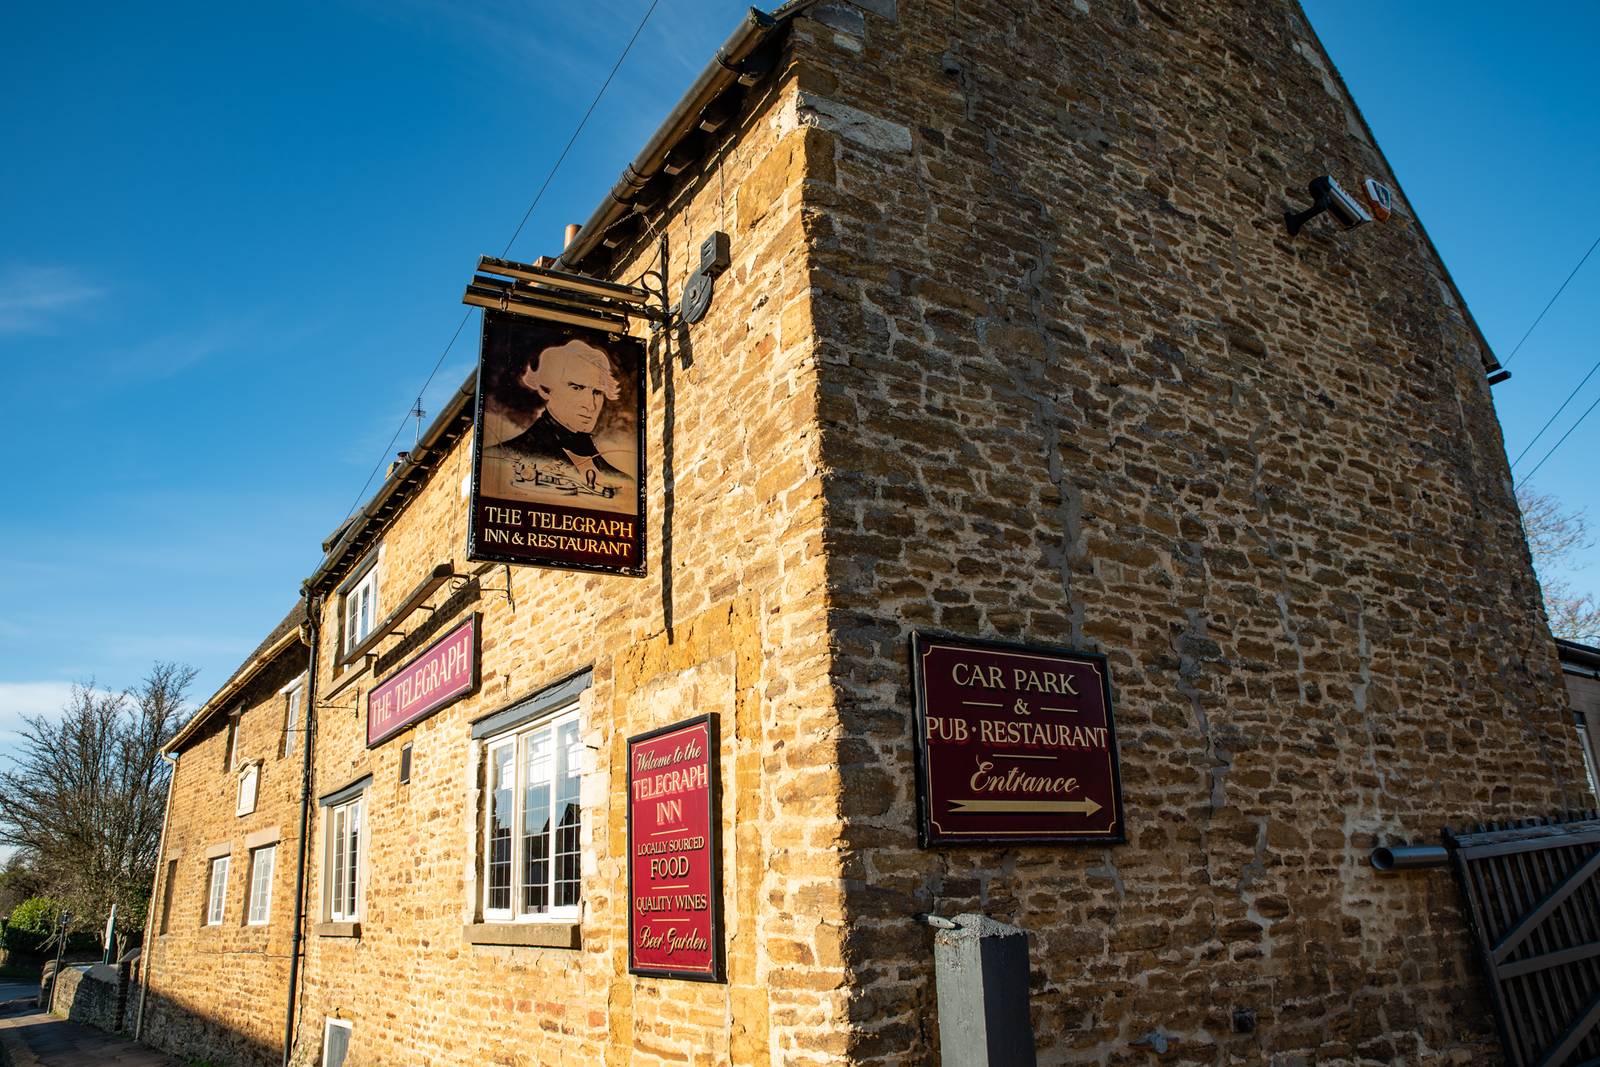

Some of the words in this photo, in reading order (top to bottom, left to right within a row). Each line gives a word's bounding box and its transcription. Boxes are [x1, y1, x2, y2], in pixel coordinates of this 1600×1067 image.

[485, 506, 522, 525] THE
[528, 511, 633, 538] TELEGRAPH
[484, 528, 510, 544] INN
[511, 532, 525, 546] &
[527, 532, 630, 557] RESTAURANT
[372, 690, 392, 727] THE
[395, 636, 469, 713] TELEGRAPH
[952, 663, 1005, 689] CAR
[1014, 669, 1078, 695] PARK
[1013, 698, 1031, 715] &
[926, 716, 968, 741] PUB
[980, 720, 1108, 748] RESTAURANT
[636, 749, 672, 772] Welcome
[673, 745, 683, 763] to
[684, 737, 702, 760] the
[632, 763, 708, 800] TELEGRAPH
[969, 754, 1080, 793] Entrance
[656, 798, 682, 824] INN
[637, 840, 668, 856] LOCALLY
[669, 836, 705, 853] SOURCED
[650, 855, 690, 878] FOOD
[636, 895, 673, 916] QUALITY
[674, 893, 707, 911] WINES
[638, 925, 664, 950] Beer
[665, 927, 708, 955] Garden
